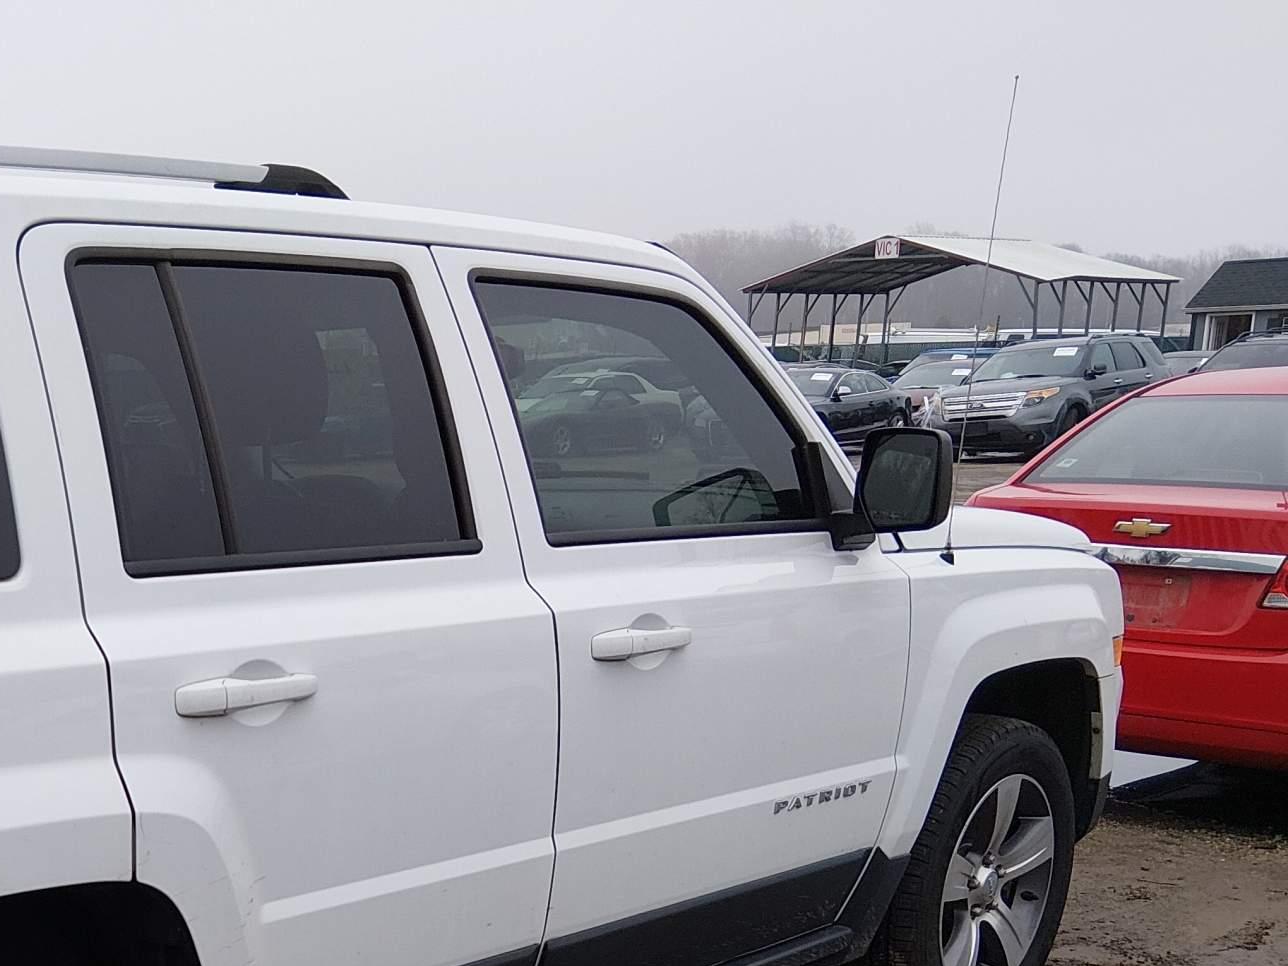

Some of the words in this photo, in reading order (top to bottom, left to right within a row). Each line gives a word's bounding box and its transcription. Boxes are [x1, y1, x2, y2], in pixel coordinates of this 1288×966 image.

[876, 240, 892, 256] VIC
[894, 239, 899, 255] 1
[773, 780, 872, 815] PATRIOT
